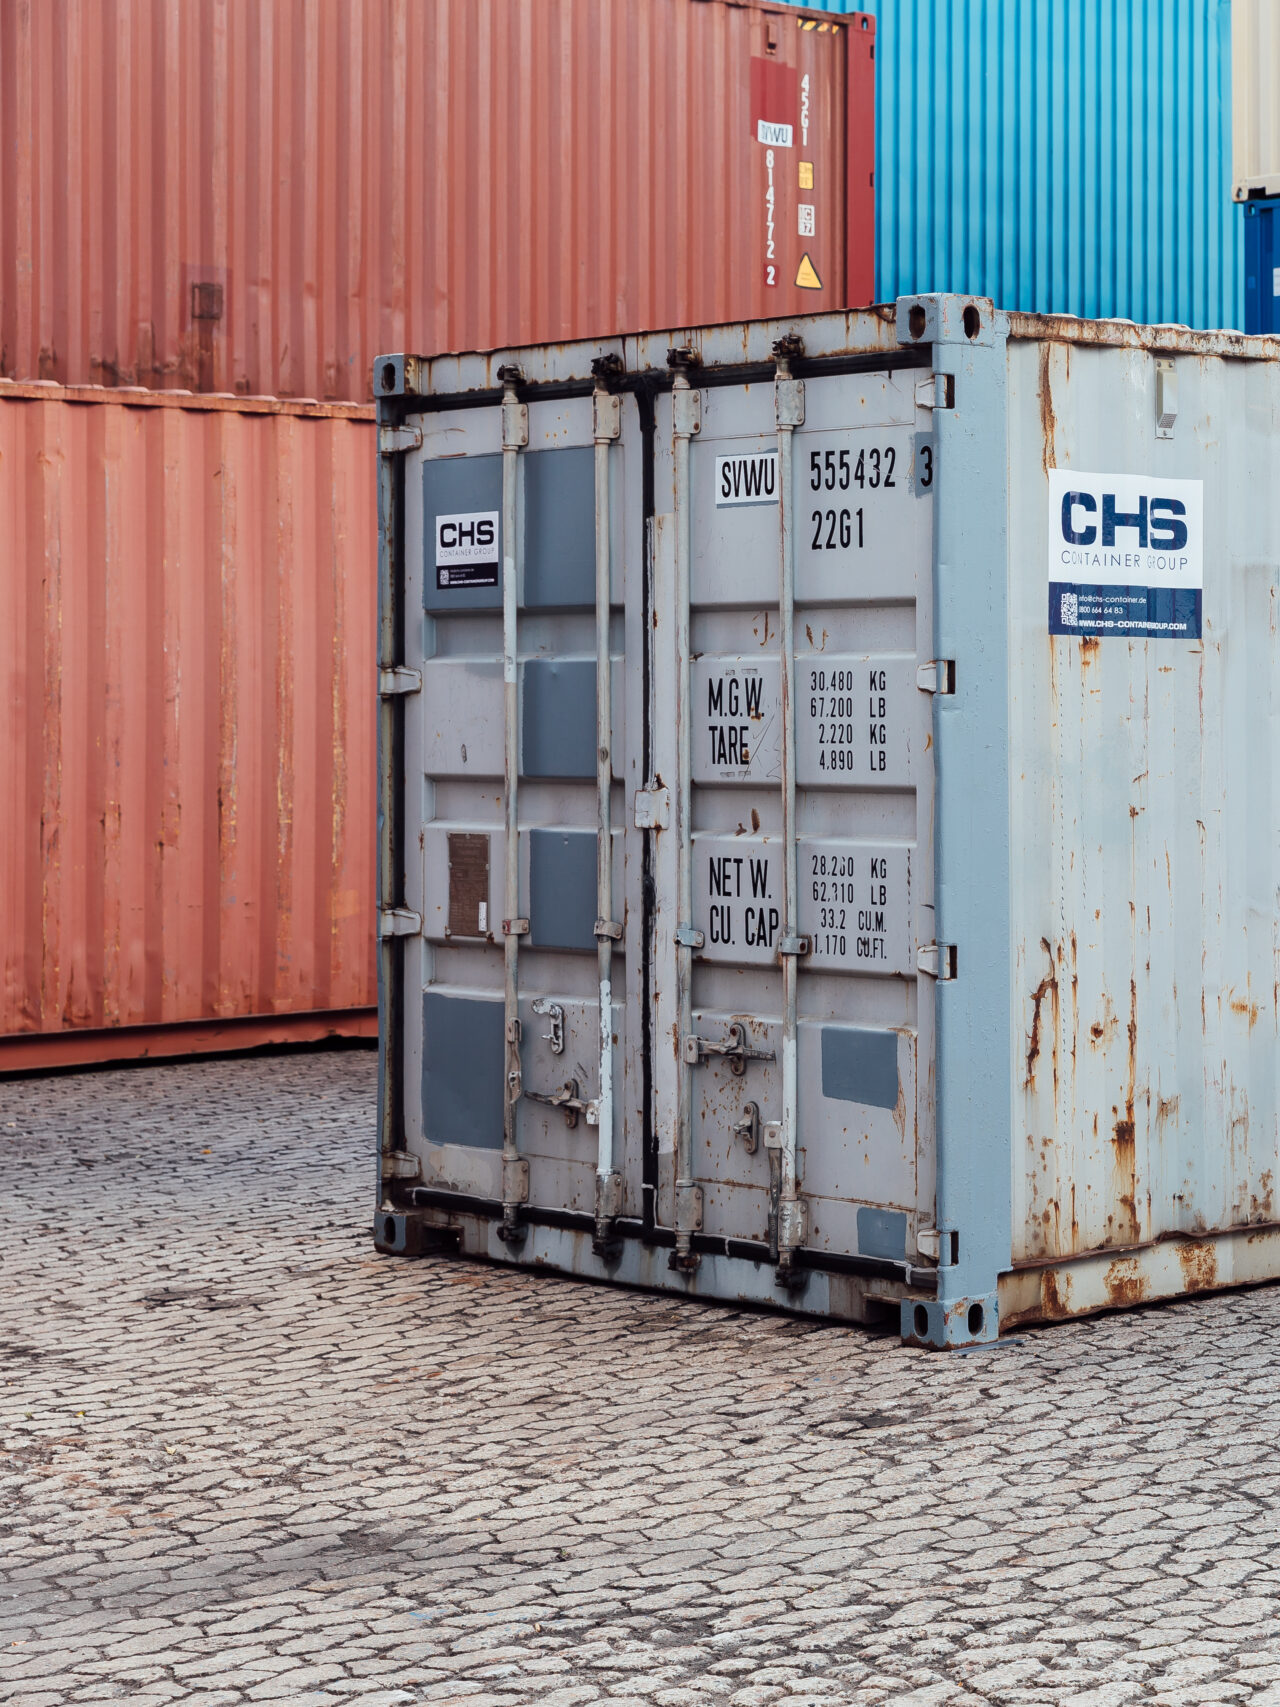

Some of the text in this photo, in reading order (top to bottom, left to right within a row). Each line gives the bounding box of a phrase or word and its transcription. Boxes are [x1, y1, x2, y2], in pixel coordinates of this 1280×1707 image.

[801, 74, 810, 146] 45G1
[765, 150, 775, 285] 814772 2
[721, 446, 933, 498] SVWU 555432 3
[811, 508, 864, 550] 22G1
[1061, 491, 1188, 550] CHS
[440, 520, 494, 548] CHS
[440, 547, 495, 557] CONTAINER GROUP
[1061, 550, 1188, 571] CONTAINER GROUP
[1091, 606, 1102, 614] 664
[1114, 607, 1124, 615] 83
[870, 670, 886, 691] KG
[708, 677, 765, 718] M.G.W.
[870, 697, 886, 718] LB
[708, 726, 750, 765] TARE
[870, 724, 886, 744] KG
[870, 750, 886, 771] LB
[709, 857, 772, 899] NET W.
[871, 858, 887, 879] KG
[871, 885, 887, 905] LB
[710, 905, 779, 948] CU. CAP
[820, 908, 887, 933] 33.2 CU.M.
[856, 937, 887, 959] CU.FT.
